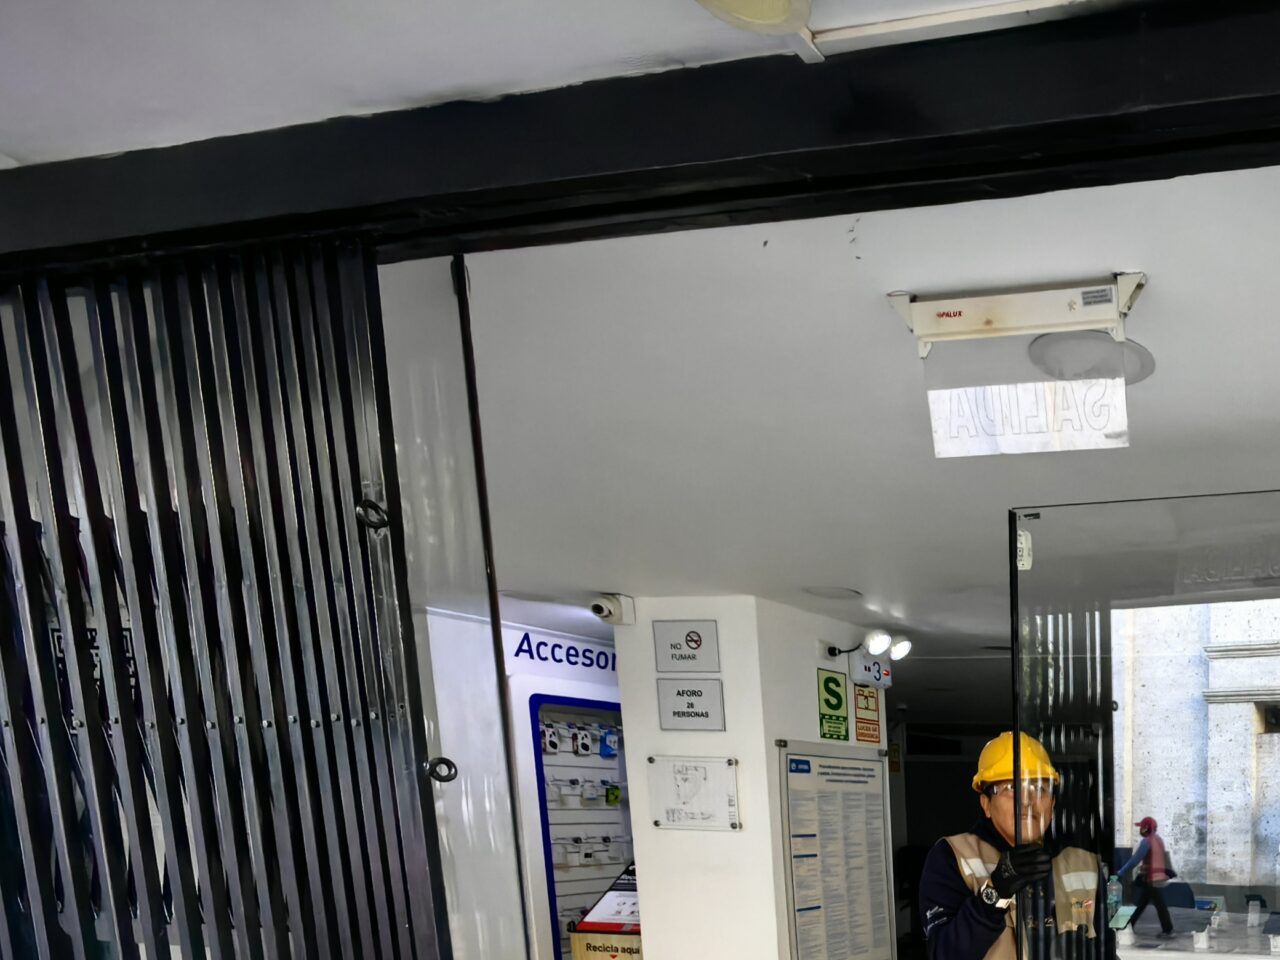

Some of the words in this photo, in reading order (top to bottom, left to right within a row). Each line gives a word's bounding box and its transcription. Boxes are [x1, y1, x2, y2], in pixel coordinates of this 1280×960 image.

[670, 642, 682, 650] NO
[671, 653, 697, 661] FUMAR
[676, 689, 703, 697] AFORO
[823, 676, 843, 711] S
[672, 710, 709, 719] PERSONAS
[585, 942, 619, 953] Recicla
